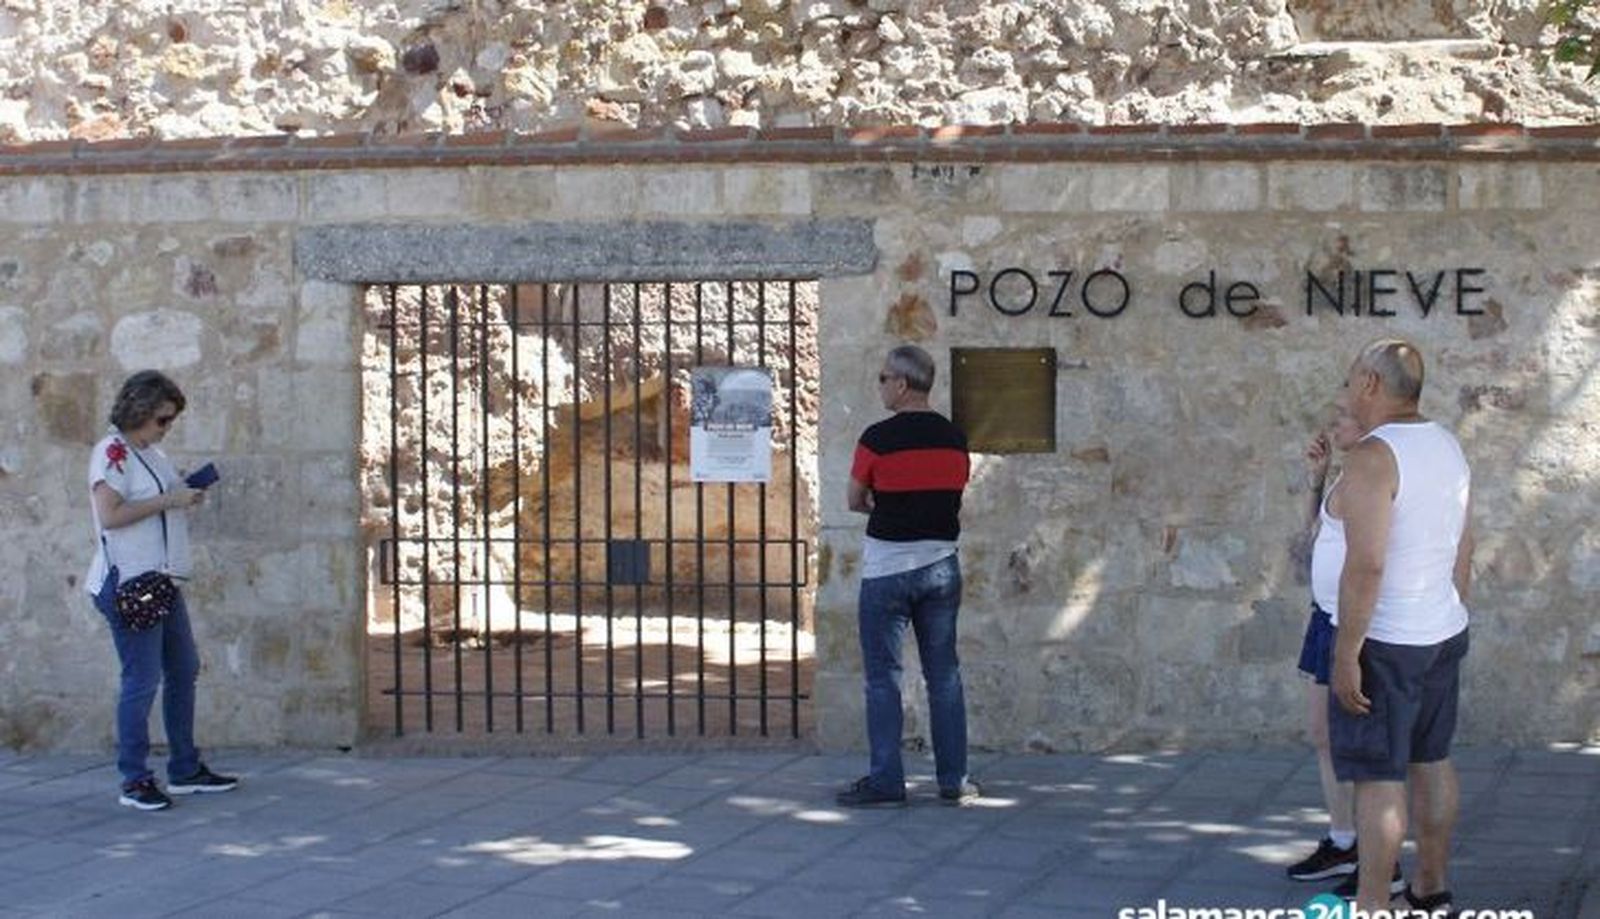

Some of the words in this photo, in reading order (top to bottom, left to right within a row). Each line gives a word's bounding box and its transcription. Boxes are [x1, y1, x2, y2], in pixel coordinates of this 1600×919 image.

[950, 267, 1131, 319] POZO
[1179, 269, 1261, 319] de
[1305, 268, 1486, 318] NIEVE
